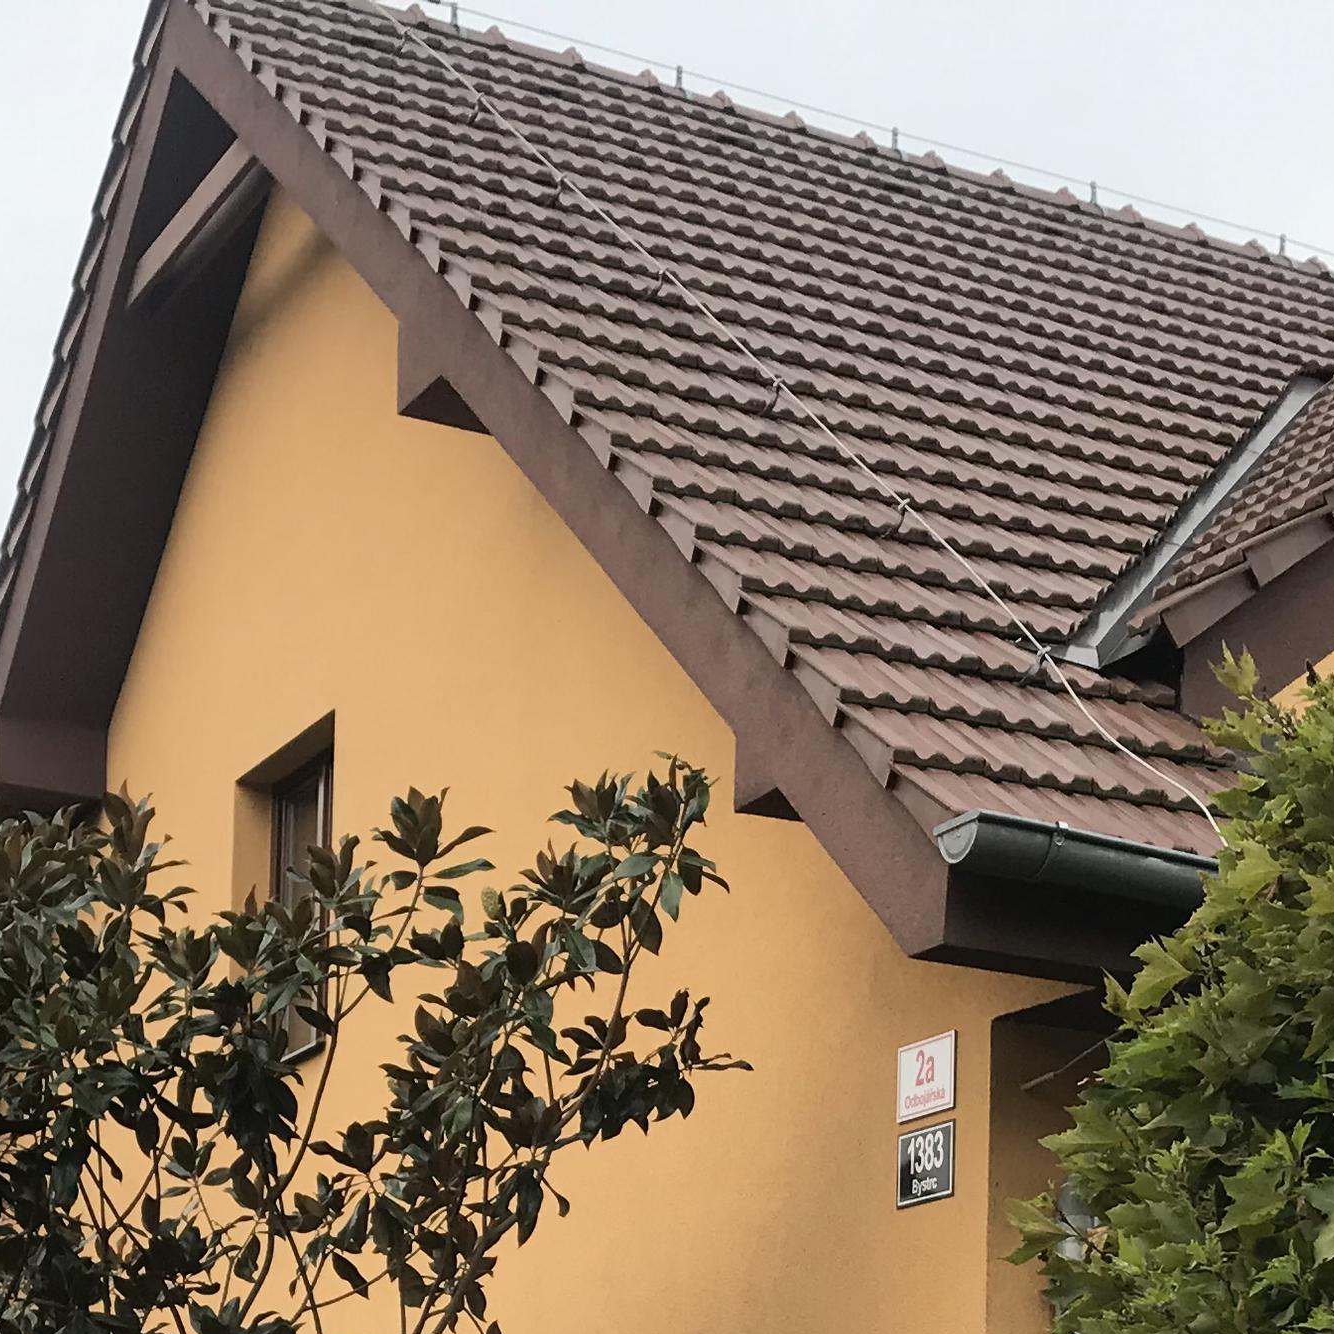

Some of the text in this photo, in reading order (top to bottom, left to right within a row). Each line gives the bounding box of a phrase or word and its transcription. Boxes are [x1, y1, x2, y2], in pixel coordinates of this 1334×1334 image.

[915, 1050, 935, 1087] 2a
[907, 1130, 944, 1175] 1383
[911, 1176, 938, 1197] Bystrc
